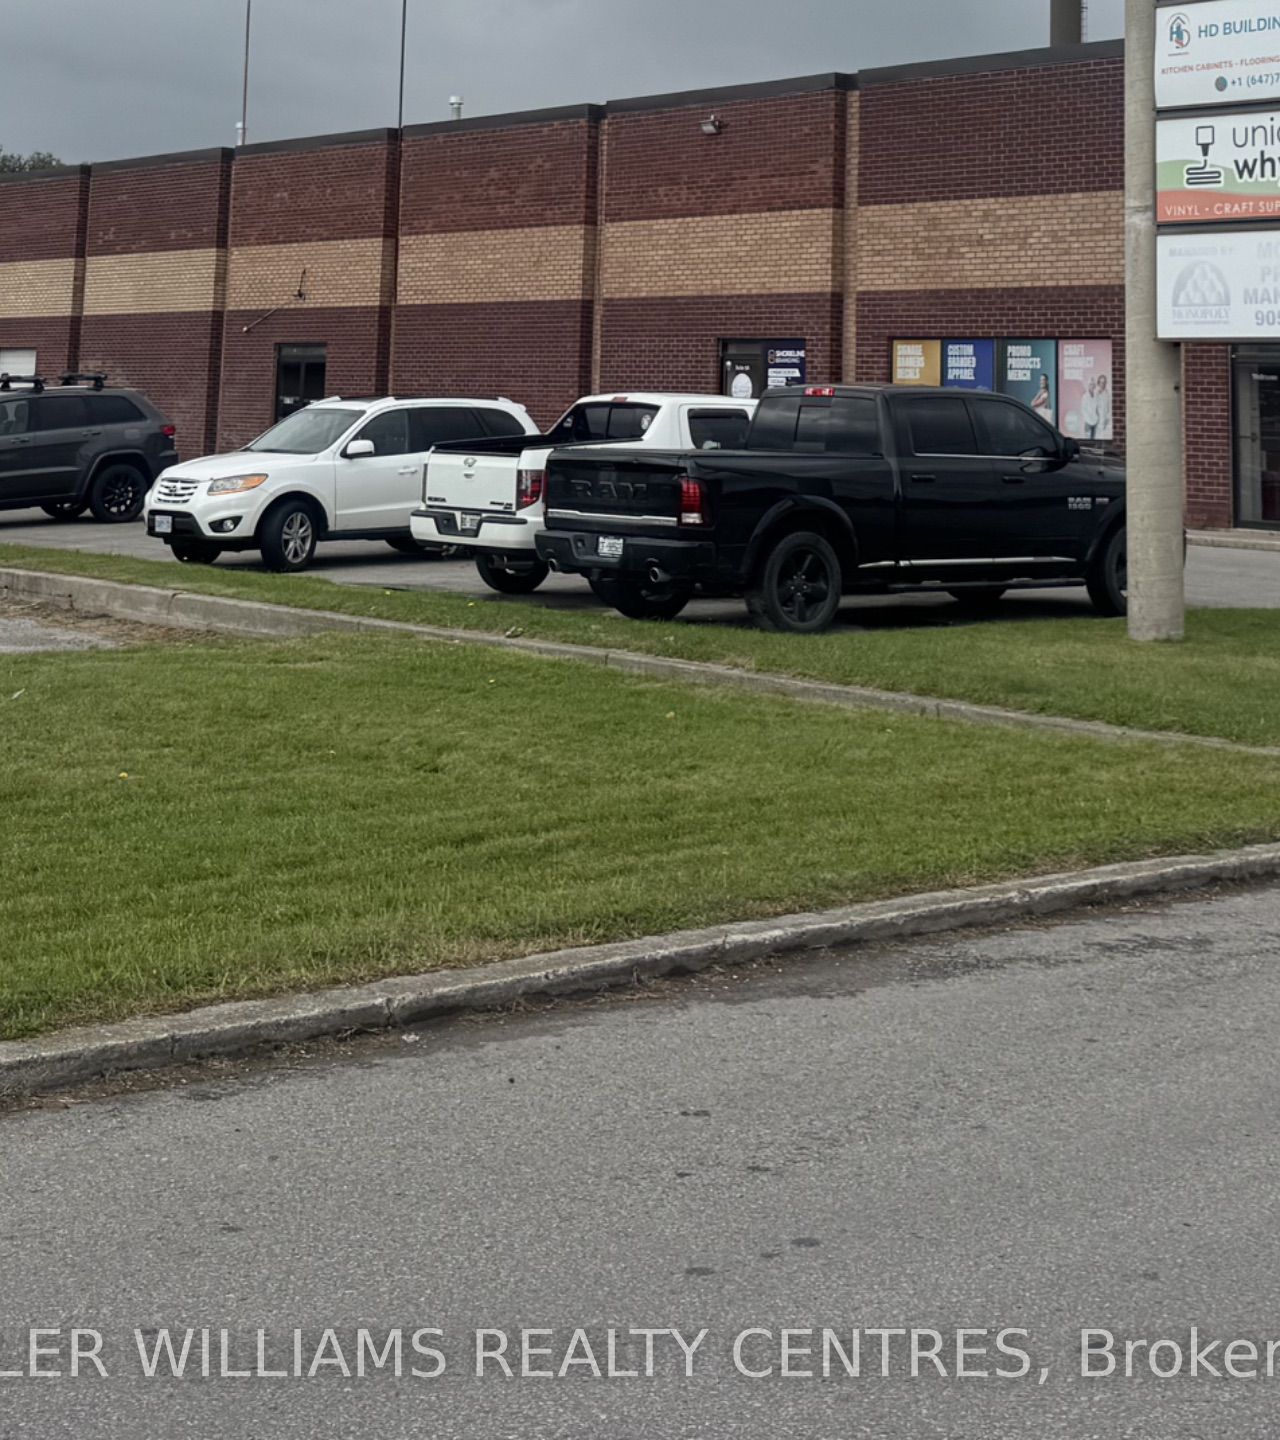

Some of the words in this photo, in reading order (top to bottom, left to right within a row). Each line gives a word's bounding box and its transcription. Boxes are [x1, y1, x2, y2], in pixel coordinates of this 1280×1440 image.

[1198, 24, 1218, 39] HD
[1161, 64, 1194, 75] KITCHEN
[1195, 60, 1233, 72] CABINETS
[1239, 55, 1280, 67] FLOORING
[1230, 76, 1243, 87] +1
[1164, 205, 1200, 217] VINYL
[1214, 201, 1254, 216] CRAFT
